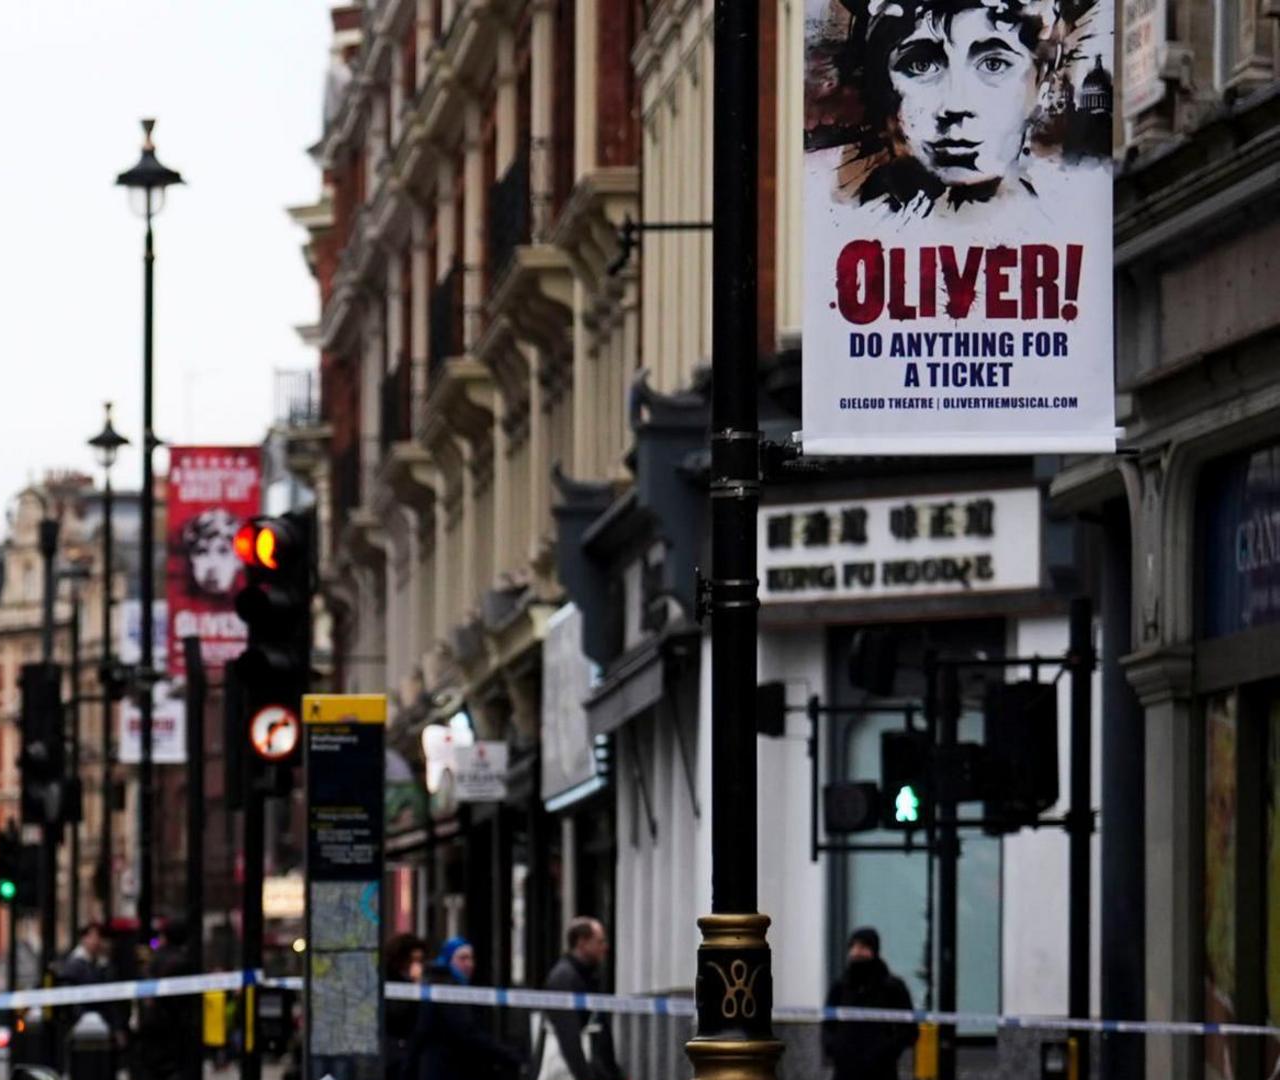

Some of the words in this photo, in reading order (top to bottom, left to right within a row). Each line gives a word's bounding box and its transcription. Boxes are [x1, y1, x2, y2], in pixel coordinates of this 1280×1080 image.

[836, 239, 1084, 325] OLIVER!
[850, 332, 883, 358] DO
[890, 332, 1015, 358] ANYTHING
[1022, 331, 1069, 357] FOR
[904, 363, 920, 388] A
[927, 362, 1014, 388] TICKET
[840, 398, 886, 410] GIELGUD
[889, 398, 934, 410] THEATRE
[943, 396, 1078, 410] OLIVERTHEMUSICAL.COM
